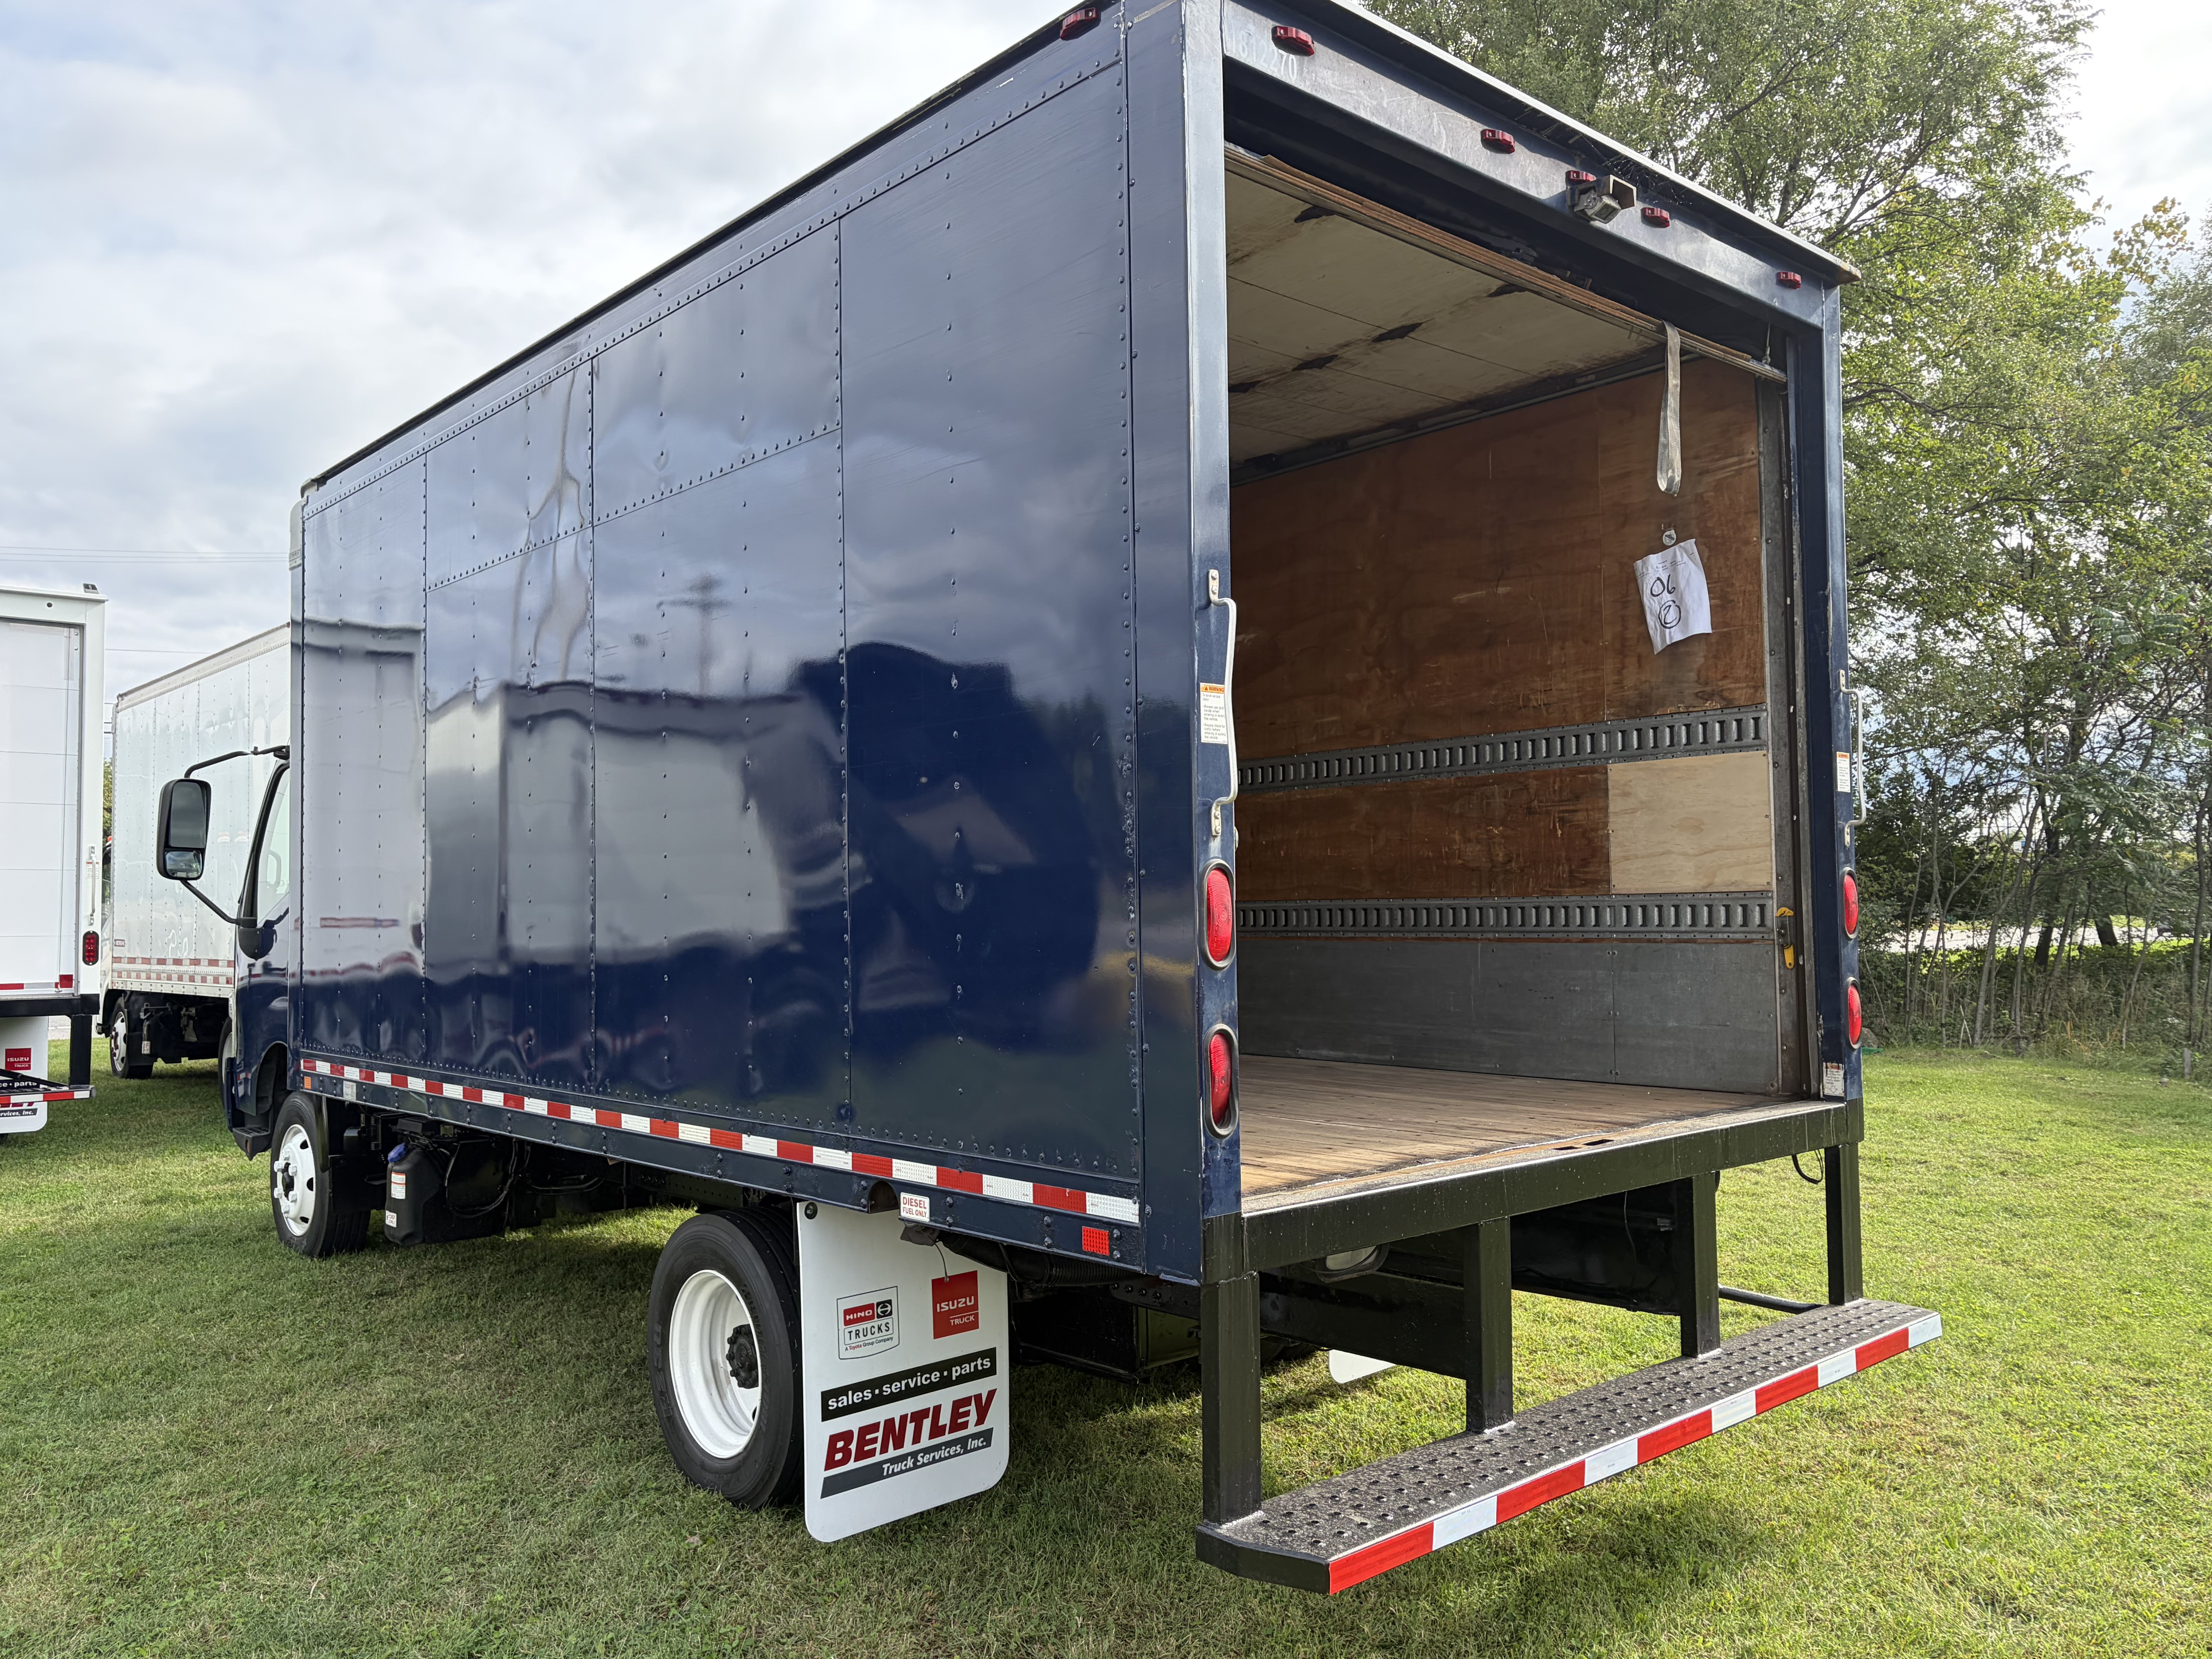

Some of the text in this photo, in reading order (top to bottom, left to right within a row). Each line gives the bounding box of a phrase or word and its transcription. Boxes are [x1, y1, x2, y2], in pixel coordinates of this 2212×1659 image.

[1650, 574, 1676, 598] 06
[1663, 605, 1677, 625] 2
[903, 1197, 927, 1209] DIESEL
[903, 1207, 927, 1218] FUEL ONLY
[936, 1295, 974, 1312] ISUZU
[846, 1310, 872, 1321] HINO
[950, 1314, 975, 1326] TRUCK
[848, 1322, 890, 1340] TRUCKS
[828, 1357, 991, 1410] sales service parts
[824, 1388, 998, 1472] BENTLEY
[882, 1437, 987, 1476] Truck Services, Inc.
